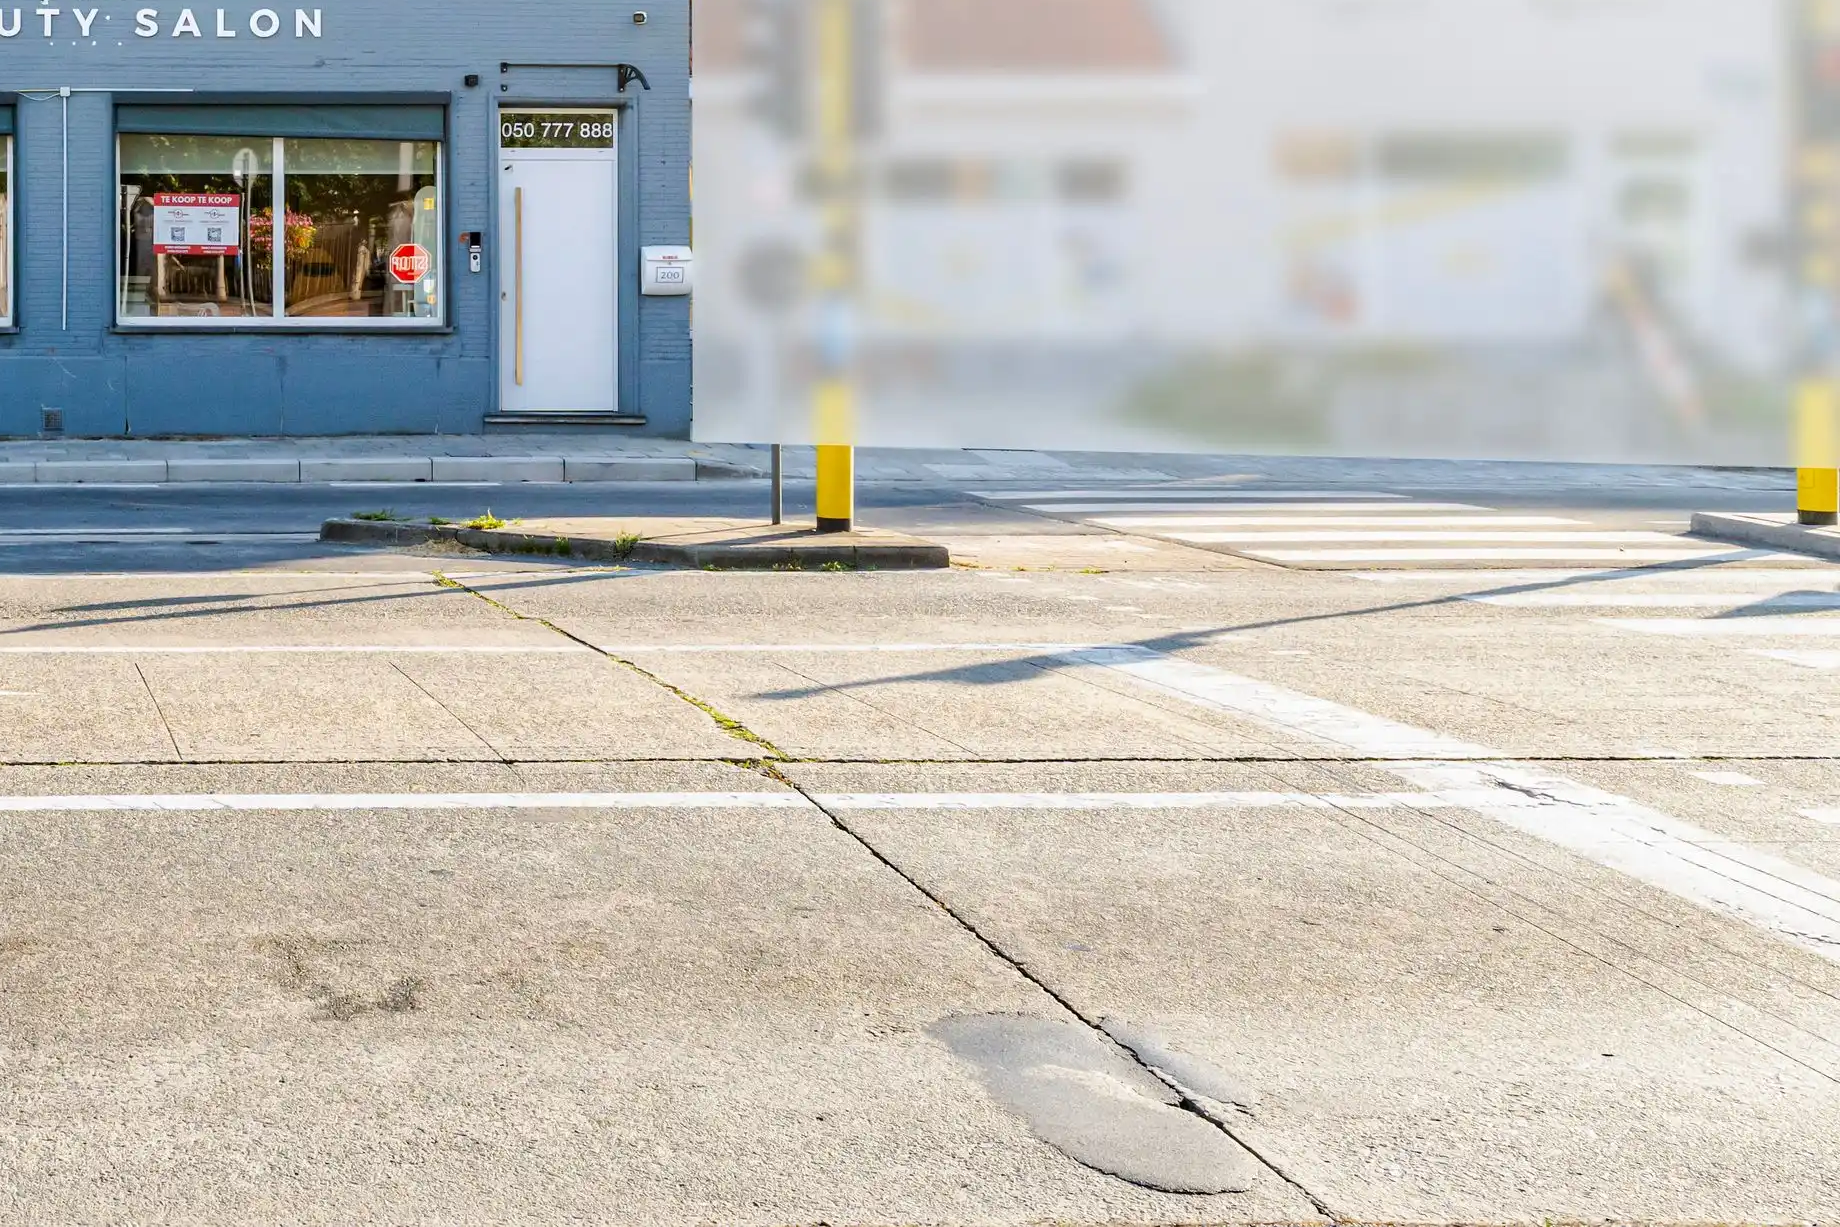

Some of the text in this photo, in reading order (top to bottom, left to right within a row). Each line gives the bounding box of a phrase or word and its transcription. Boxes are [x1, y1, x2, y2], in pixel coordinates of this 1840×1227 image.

[134, 7, 323, 38] SALON
[501, 122, 613, 138] 050 777 888
[172, 196, 196, 204] KOOP
[208, 197, 233, 205] KOOP
